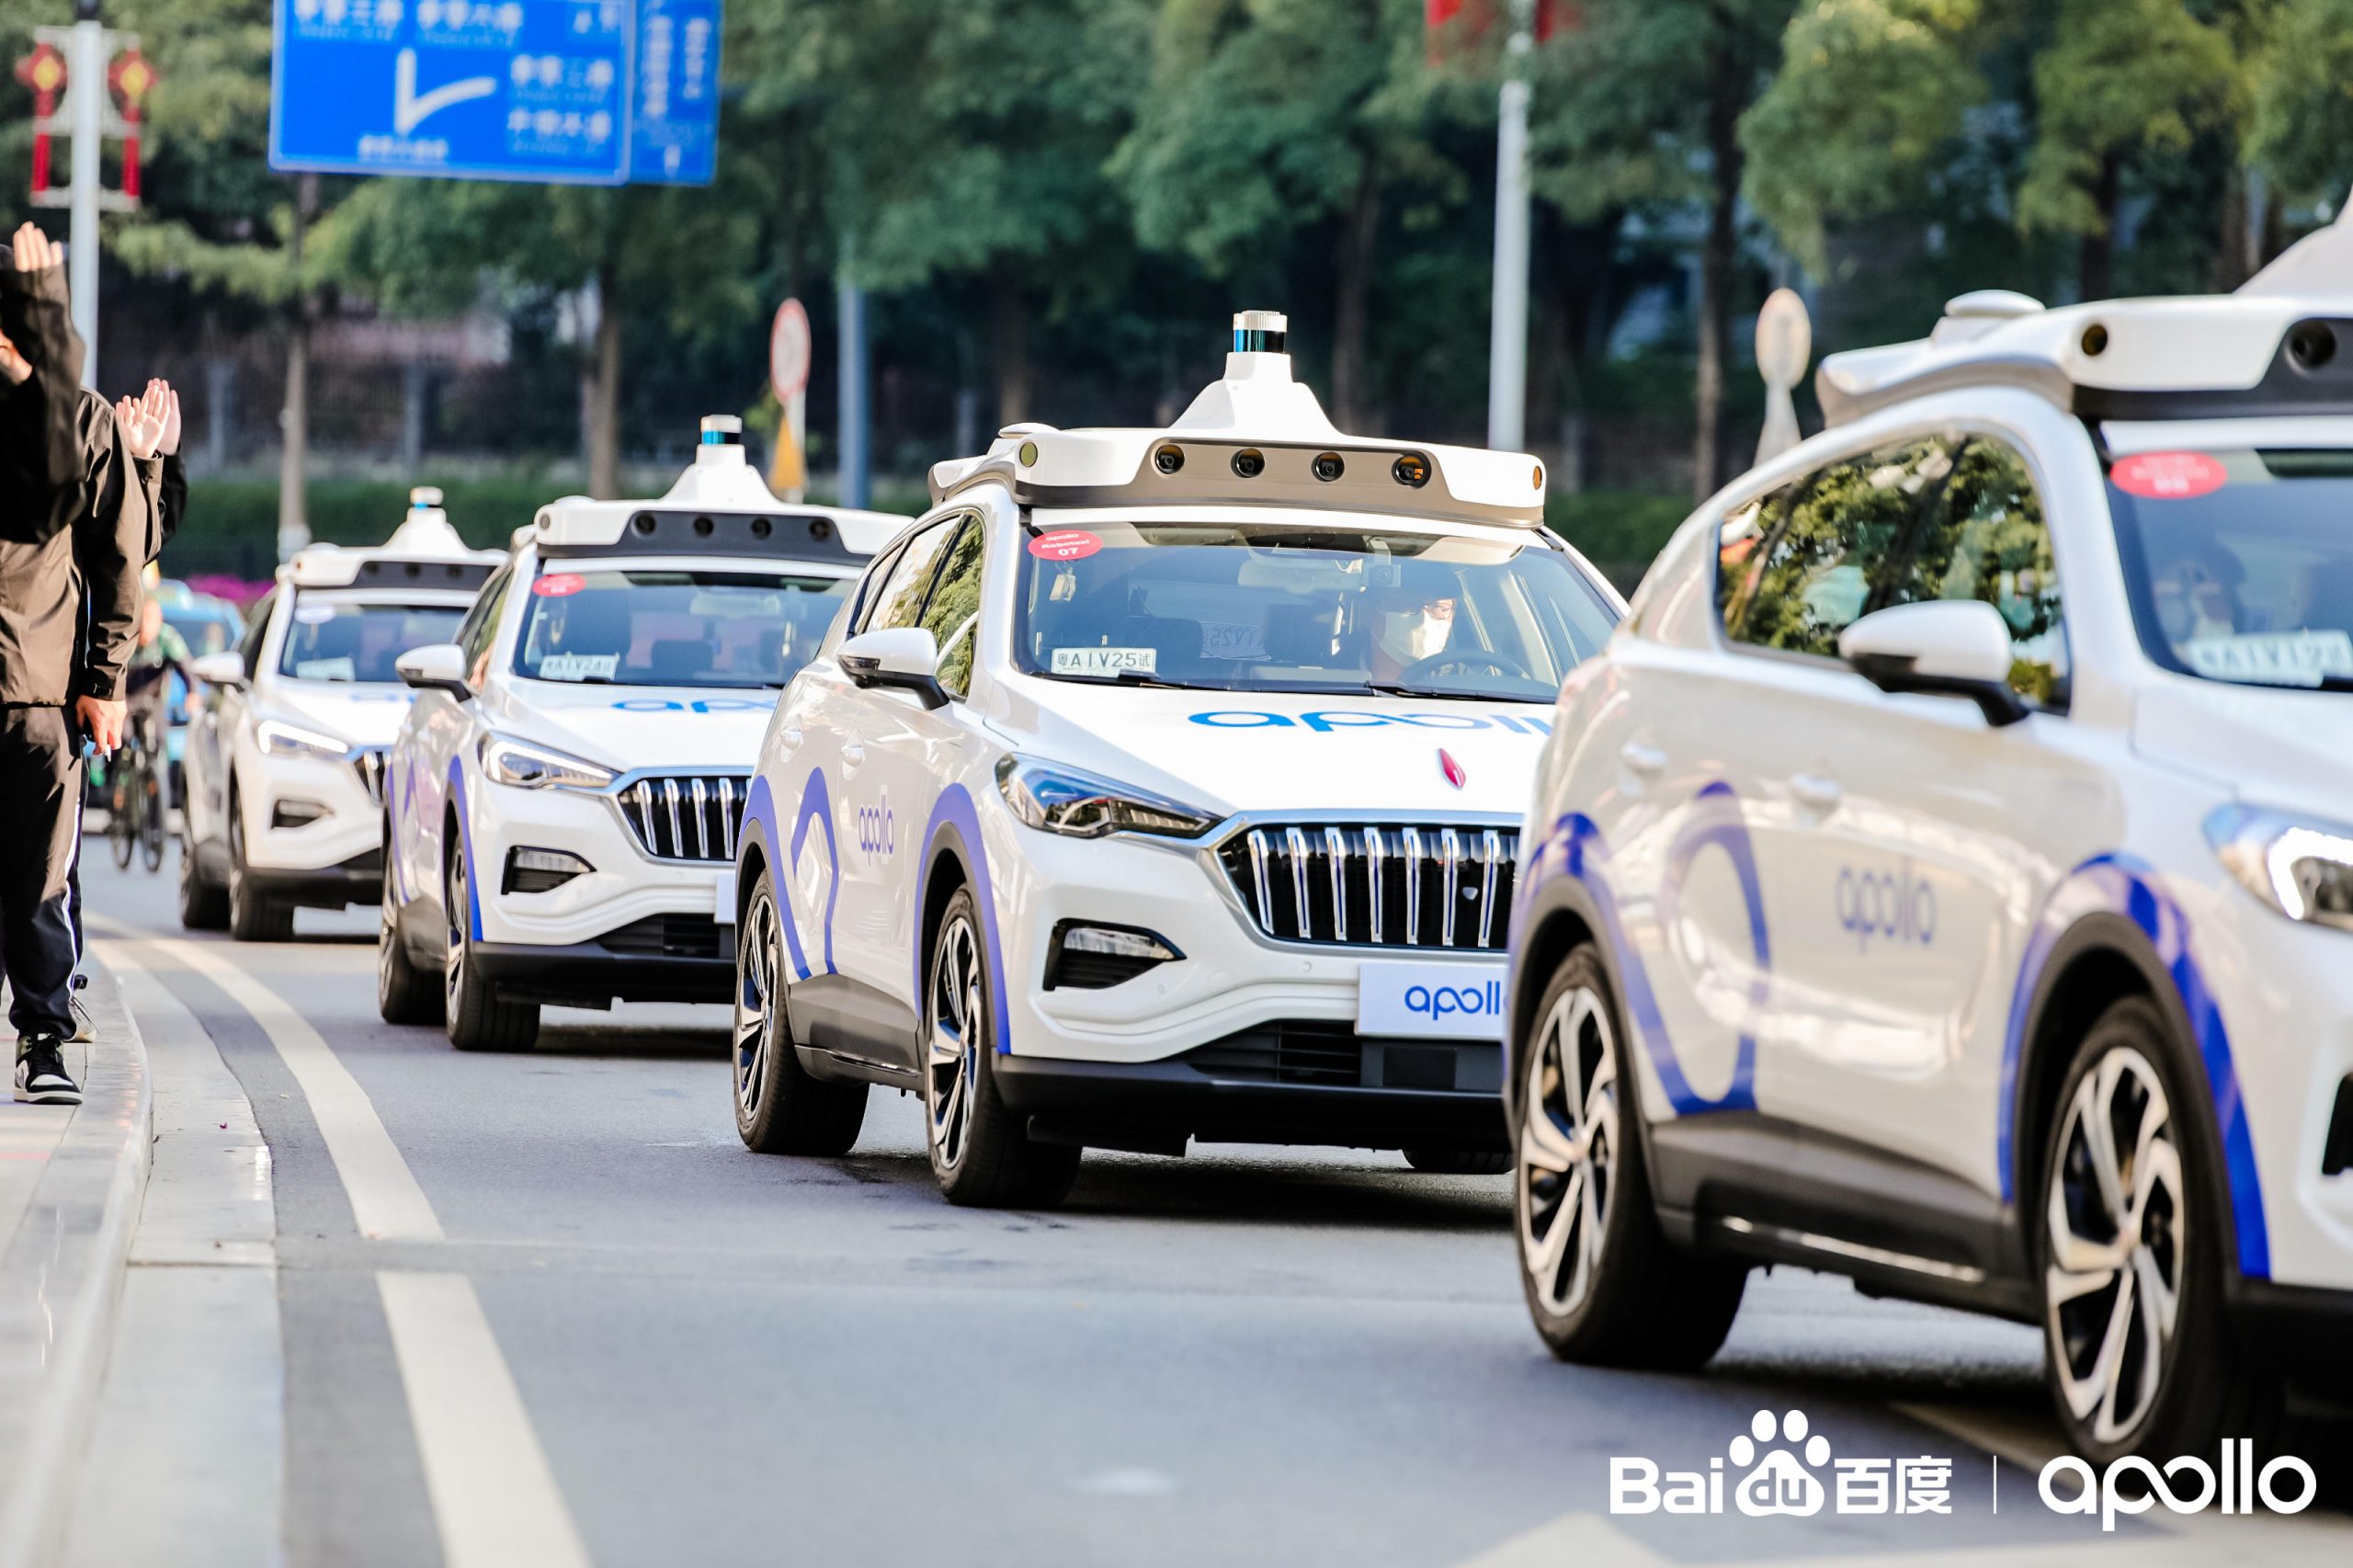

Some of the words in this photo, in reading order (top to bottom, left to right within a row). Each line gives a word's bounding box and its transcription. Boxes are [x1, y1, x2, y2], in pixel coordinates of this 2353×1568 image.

[1058, 548, 1079, 556] 07
[1188, 710, 1552, 736] apoll
[858, 794, 894, 867] apollo
[1836, 855, 1936, 955] apollo
[1404, 981, 1500, 1020] apoll
